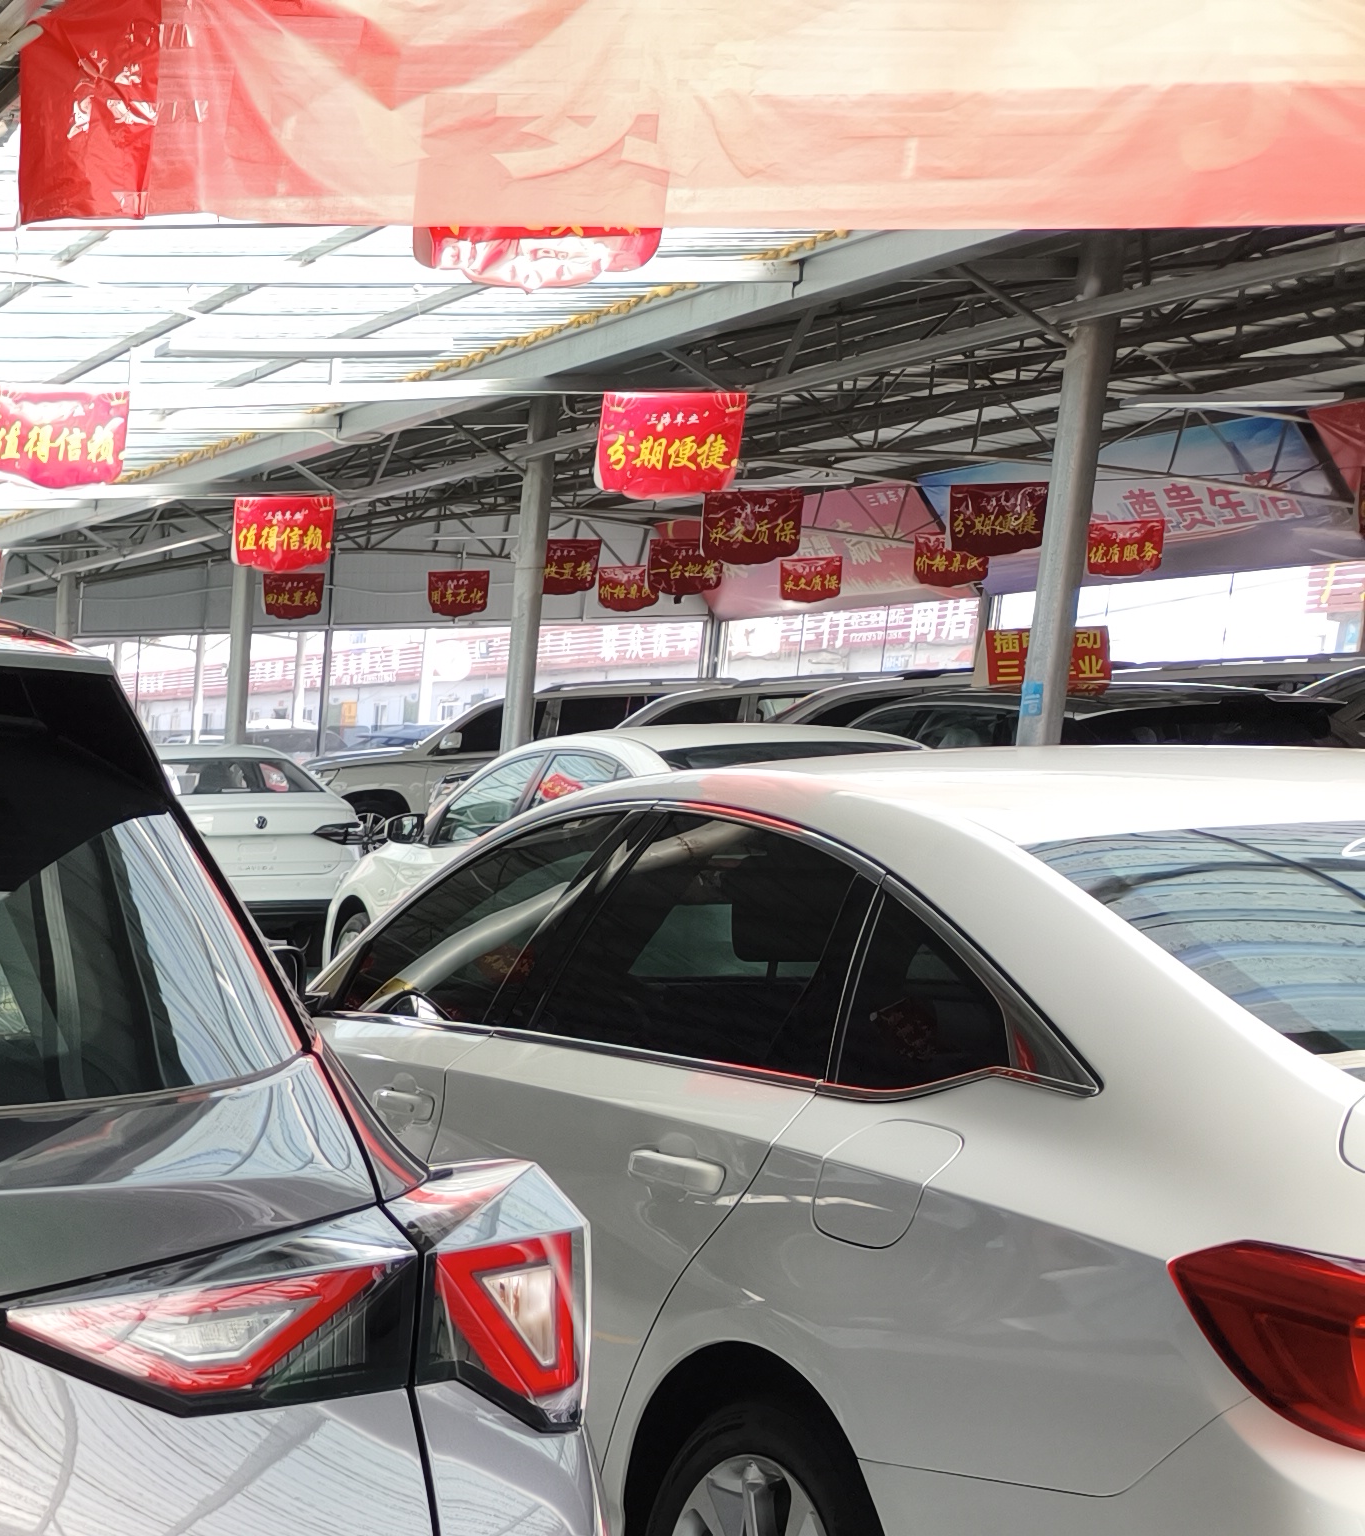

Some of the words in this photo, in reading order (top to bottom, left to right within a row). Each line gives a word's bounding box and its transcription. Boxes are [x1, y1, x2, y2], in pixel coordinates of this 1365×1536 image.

[606, 433, 730, 471] 分期便捷
[1091, 469, 1304, 535] 尊贵生活
[238, 523, 323, 553] 值得信赖
[709, 520, 798, 547] 永久质保
[1088, 540, 1159, 564] 优质服务
[431, 587, 485, 605] 用车无忧
[784, 574, 840, 594] 永久质保
[994, 629, 1101, 654] 插动
[996, 655, 1105, 682] 三业
